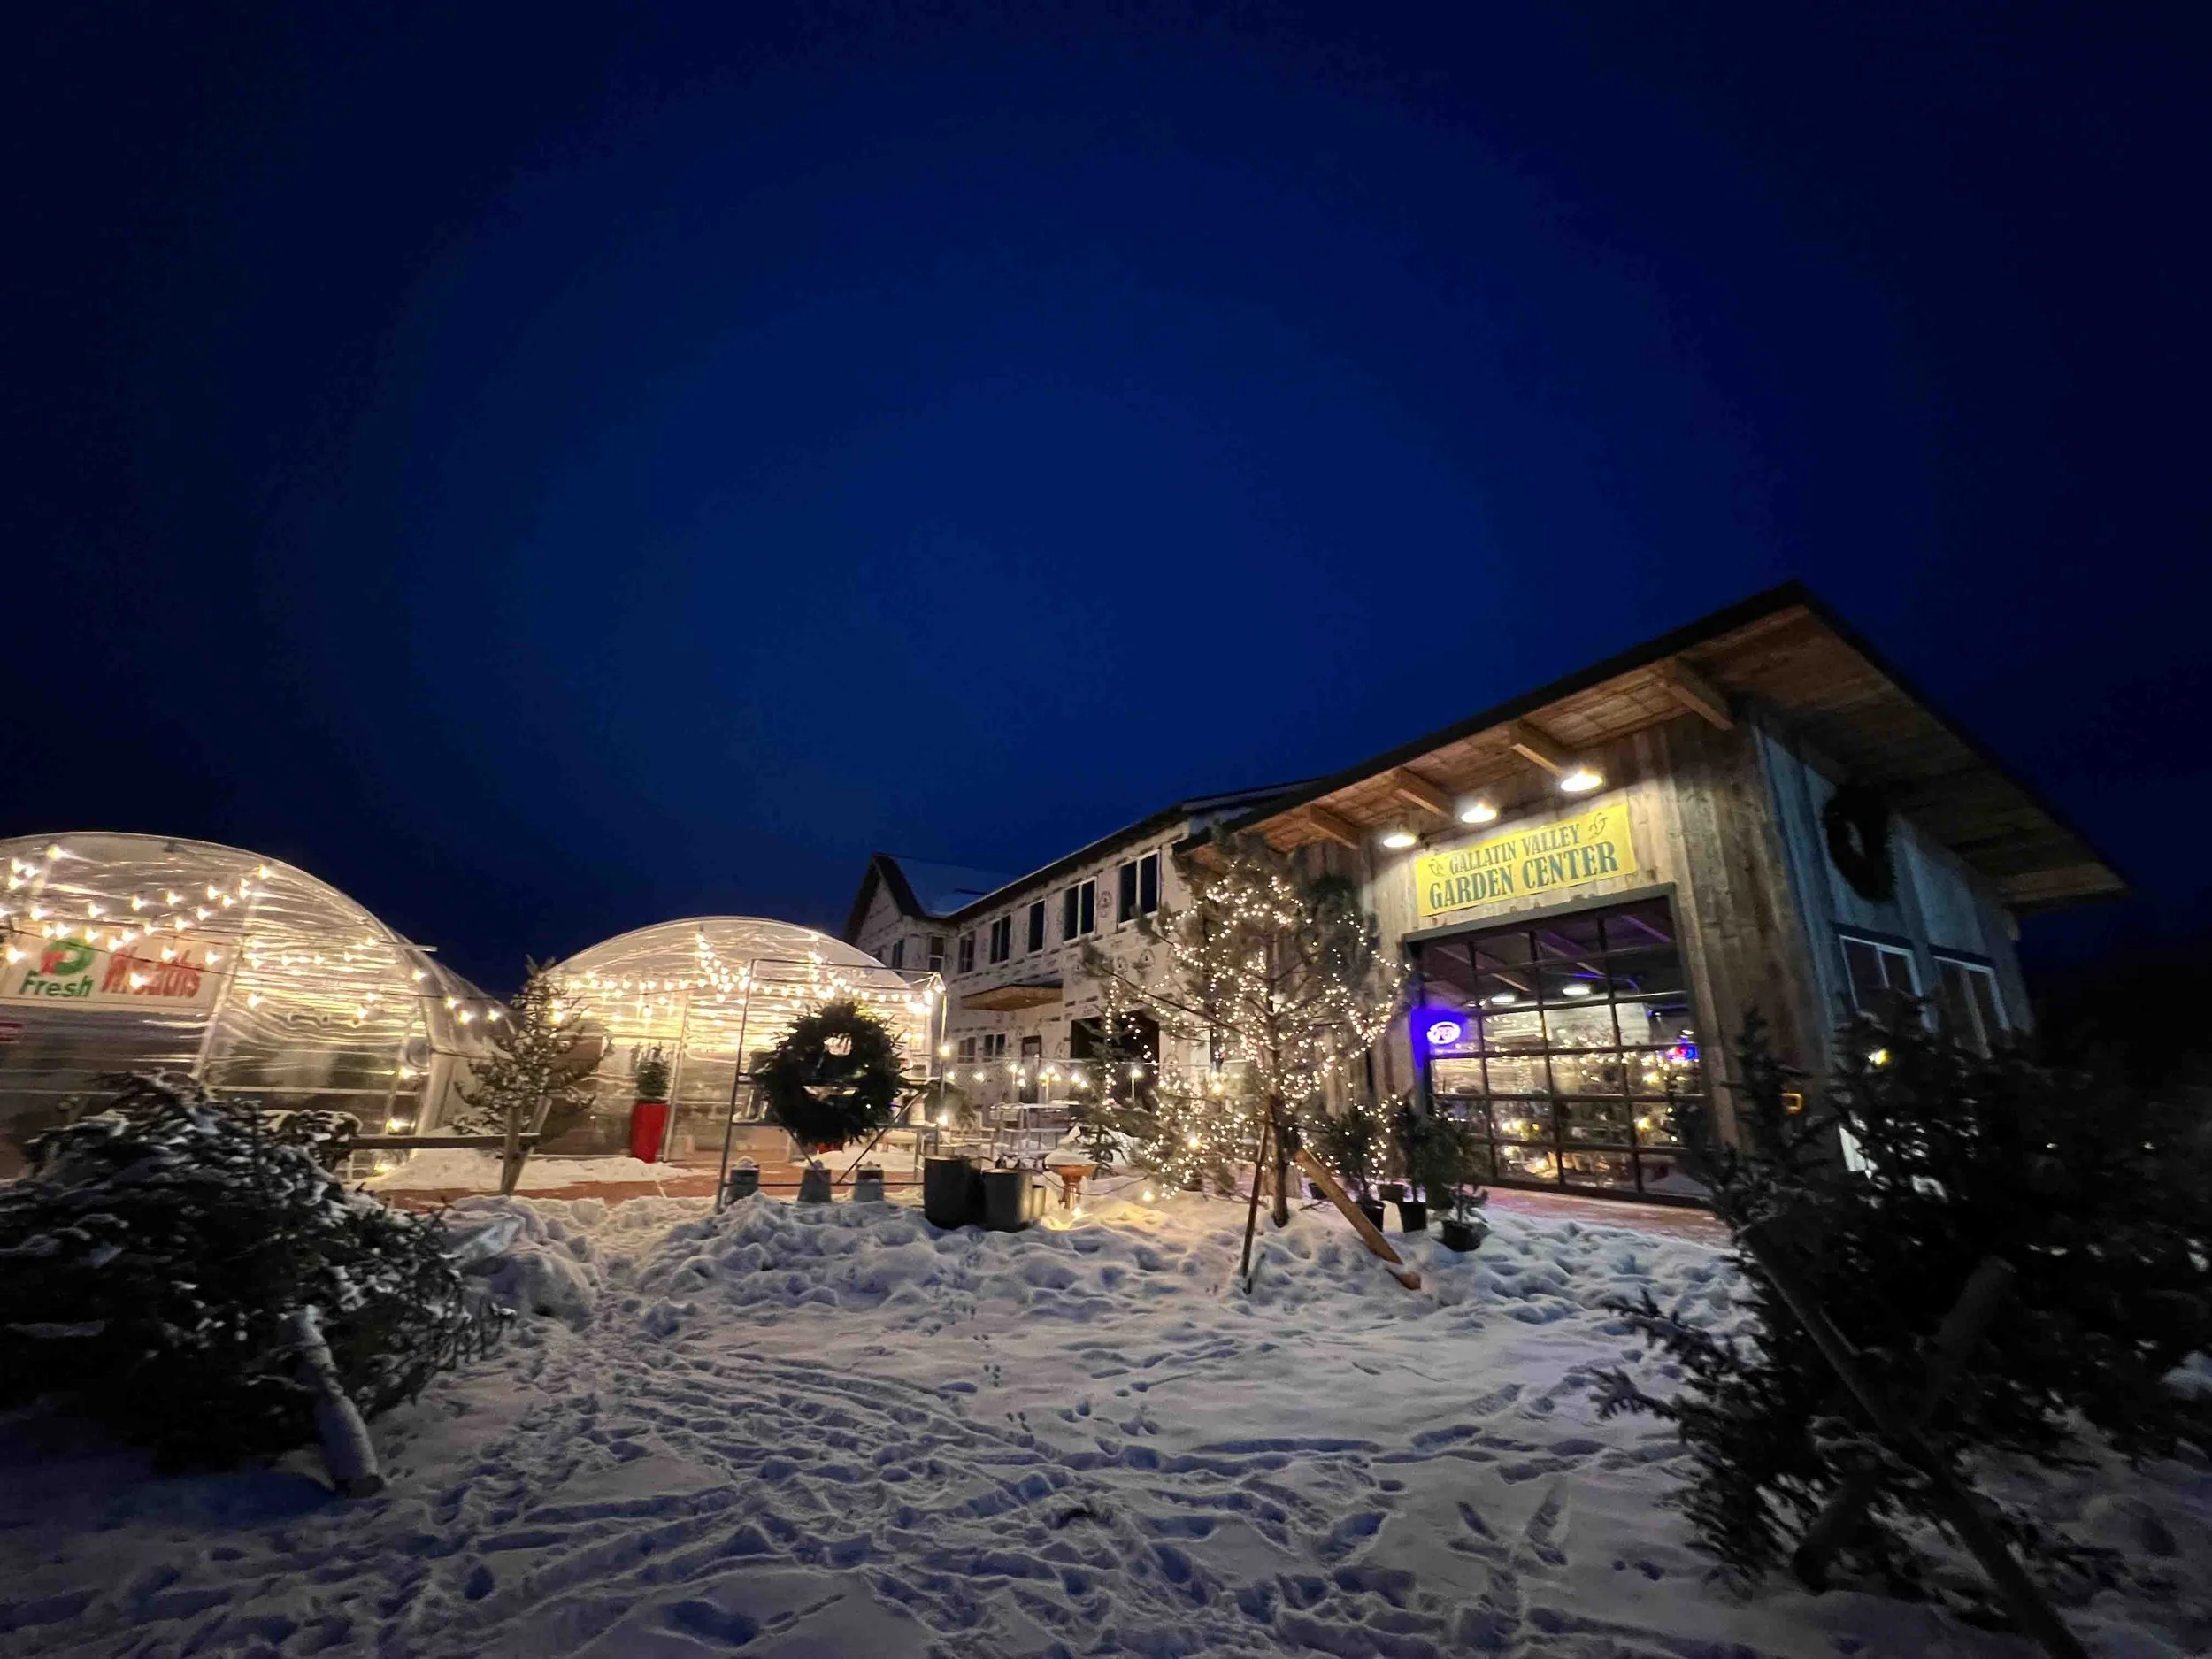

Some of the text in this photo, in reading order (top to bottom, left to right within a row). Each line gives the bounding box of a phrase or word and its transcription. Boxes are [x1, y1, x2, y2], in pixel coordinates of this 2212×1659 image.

[1429, 841, 1619, 910] GARDEN CENTER
[1448, 823, 1580, 876] GALLATIN VALLEY
[19, 969, 94, 998] Fresh
